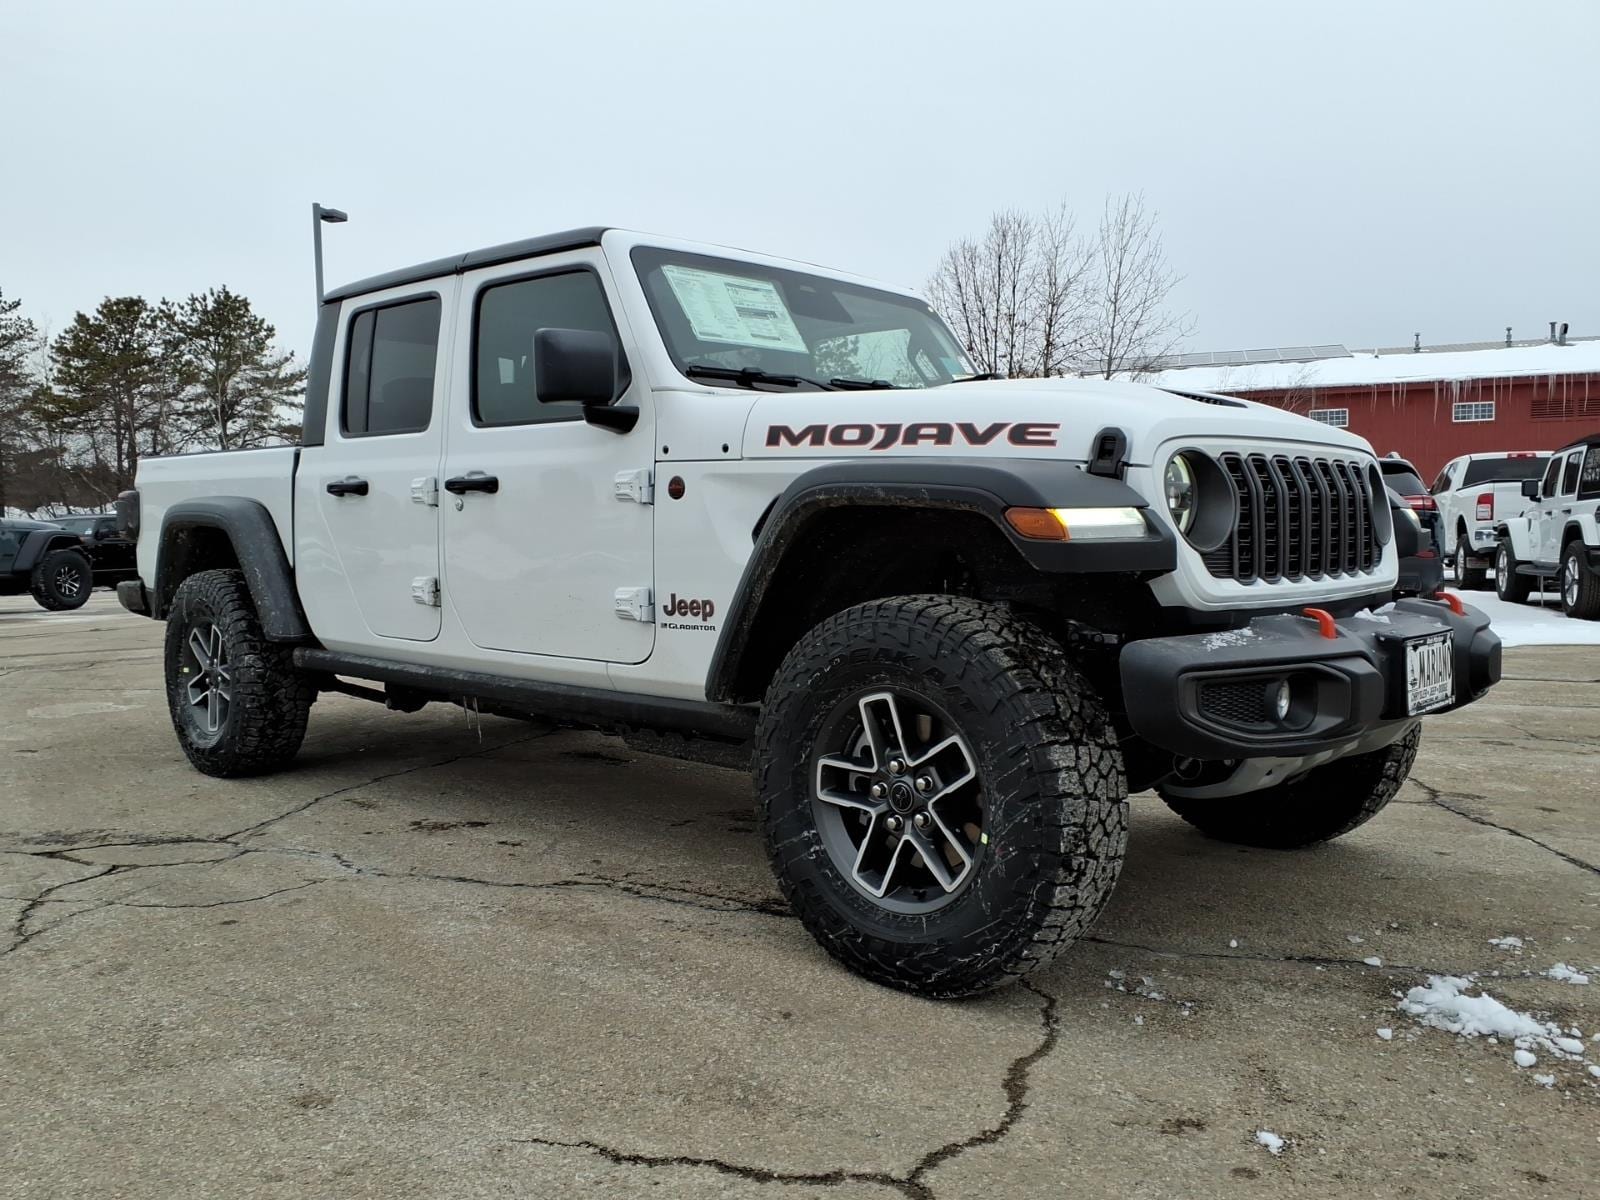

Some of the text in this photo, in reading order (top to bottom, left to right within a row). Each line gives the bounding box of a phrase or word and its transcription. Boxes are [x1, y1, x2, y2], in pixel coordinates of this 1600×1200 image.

[765, 422, 1061, 450] MOJAVE
[662, 592, 715, 622] Jeep
[668, 622, 716, 631] GLADIATOR
